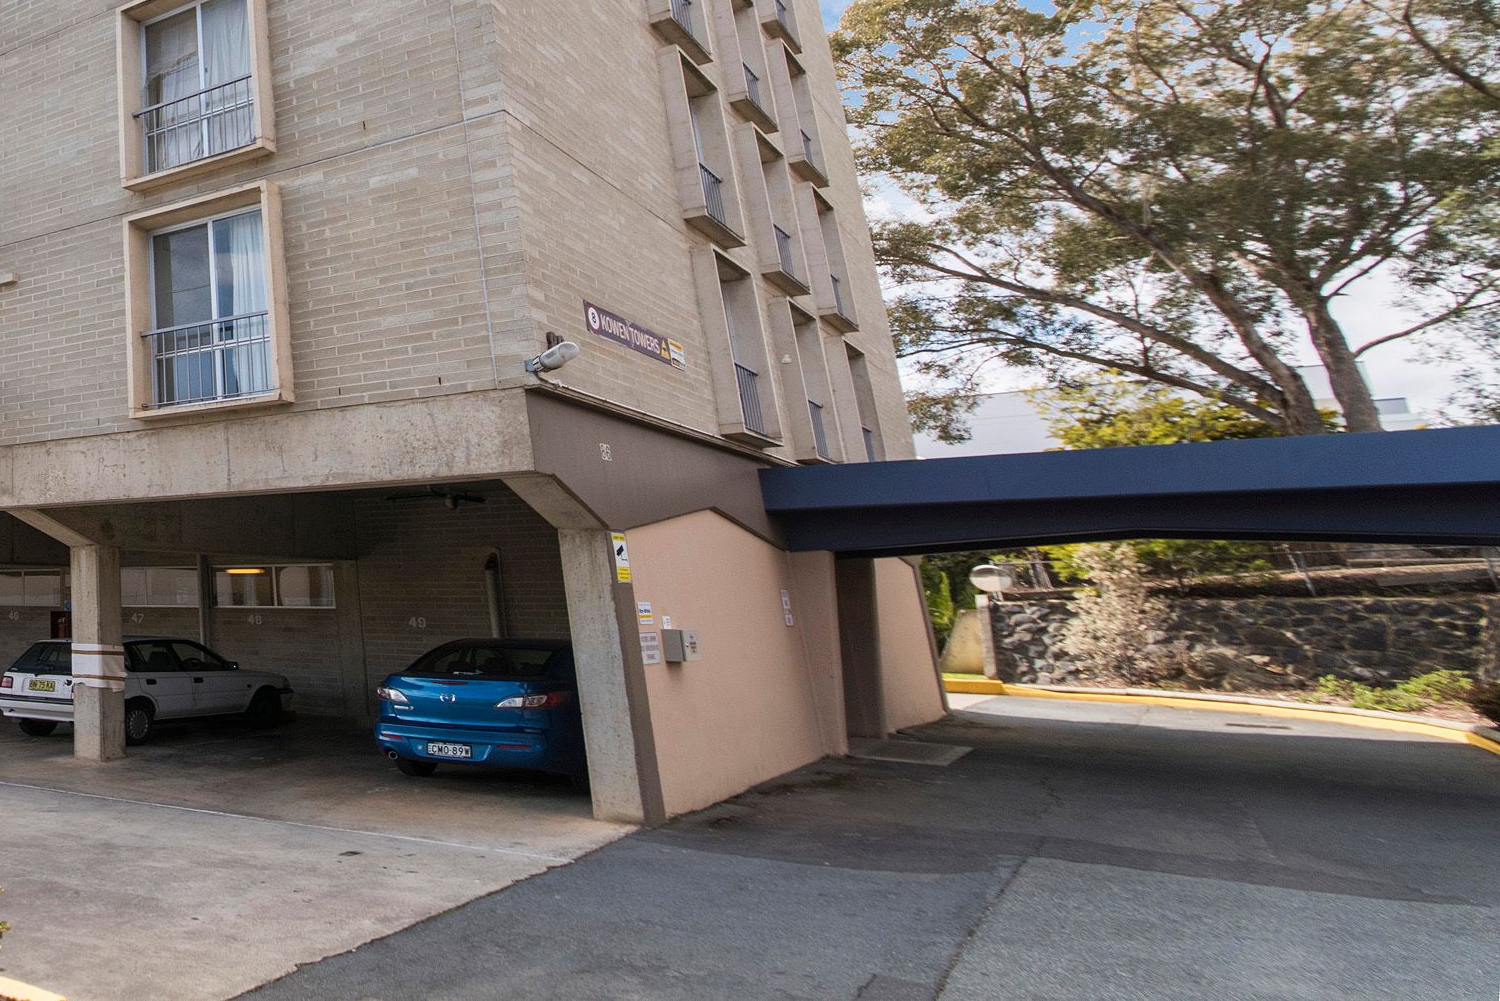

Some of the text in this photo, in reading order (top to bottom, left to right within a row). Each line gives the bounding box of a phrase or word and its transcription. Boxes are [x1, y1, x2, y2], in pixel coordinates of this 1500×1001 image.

[600, 314, 629, 341] KOWEN
[628, 327, 660, 354] TOWERS
[131, 613, 145, 624] 47
[248, 615, 262, 625] 48
[408, 616, 427, 628] 49
